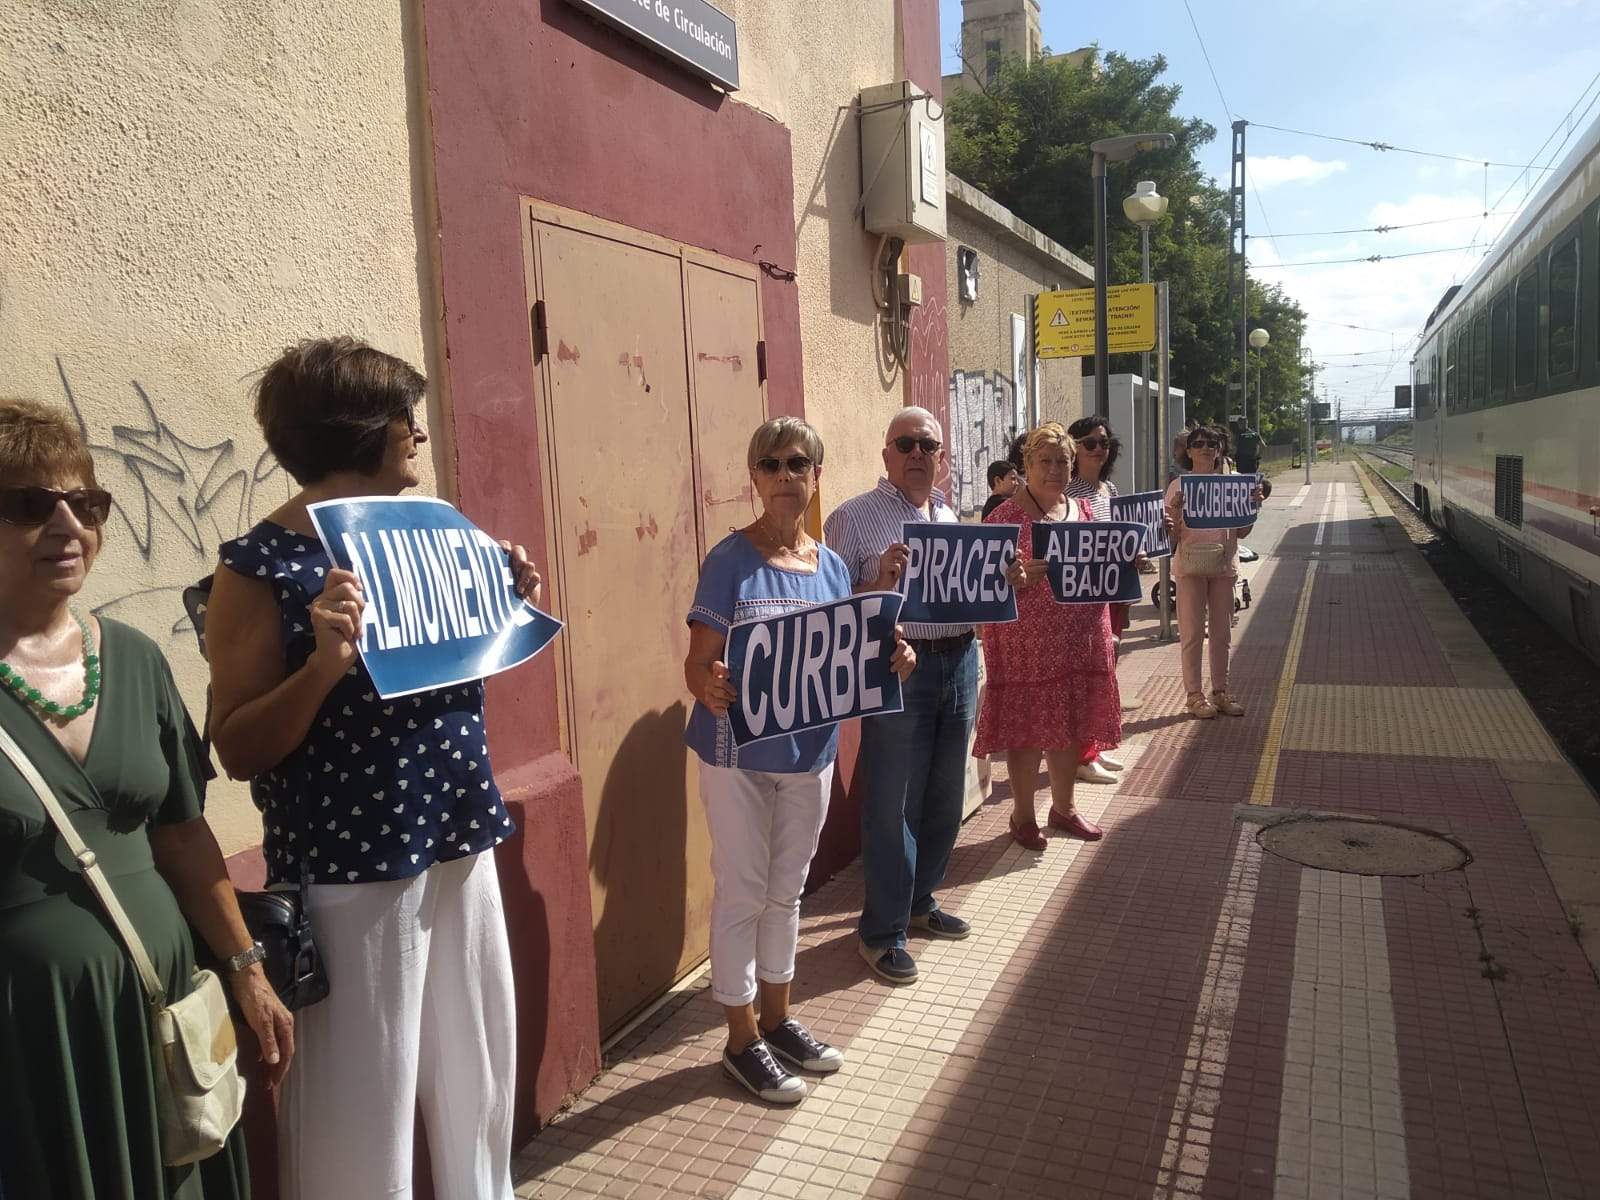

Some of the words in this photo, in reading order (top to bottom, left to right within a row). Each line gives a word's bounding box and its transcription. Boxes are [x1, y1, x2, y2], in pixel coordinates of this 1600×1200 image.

[655, 0, 670, 23] de
[674, 8, 732, 60] Circulación
[1182, 481, 1257, 518] ALCUBIERRE
[904, 537, 1014, 603] PIRACES
[1046, 530, 1140, 564] ALBERO
[341, 528, 535, 653] ALMUNIENTE
[1062, 564, 1120, 597] BAJO
[742, 597, 883, 736] CURBE
